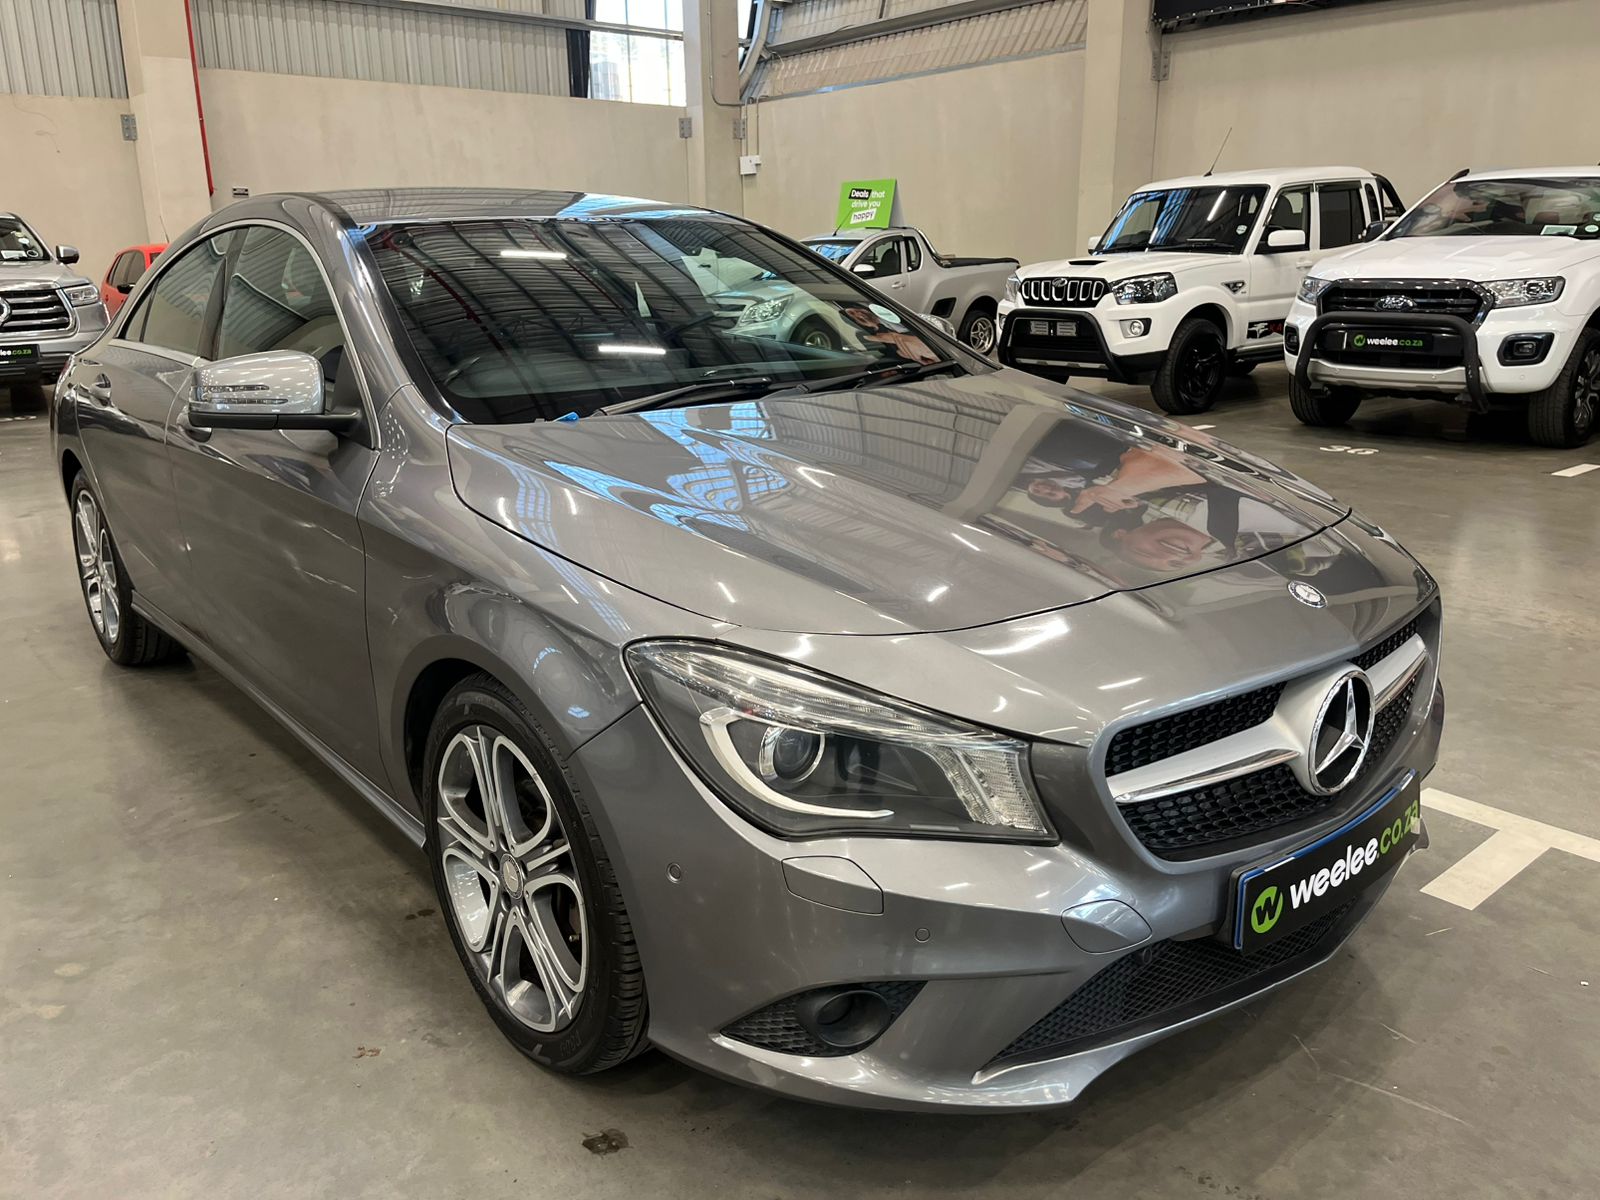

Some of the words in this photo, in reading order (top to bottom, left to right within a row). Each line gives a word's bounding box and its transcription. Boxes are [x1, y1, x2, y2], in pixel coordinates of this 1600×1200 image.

[851, 190, 869, 199] Deals
[871, 191, 886, 199] that
[851, 200, 868, 208] drive
[869, 201, 881, 209] you
[853, 211, 875, 221] happy
[1366, 337, 1423, 347] weelee.co.za
[1290, 800, 1418, 910] weelee.co.za
